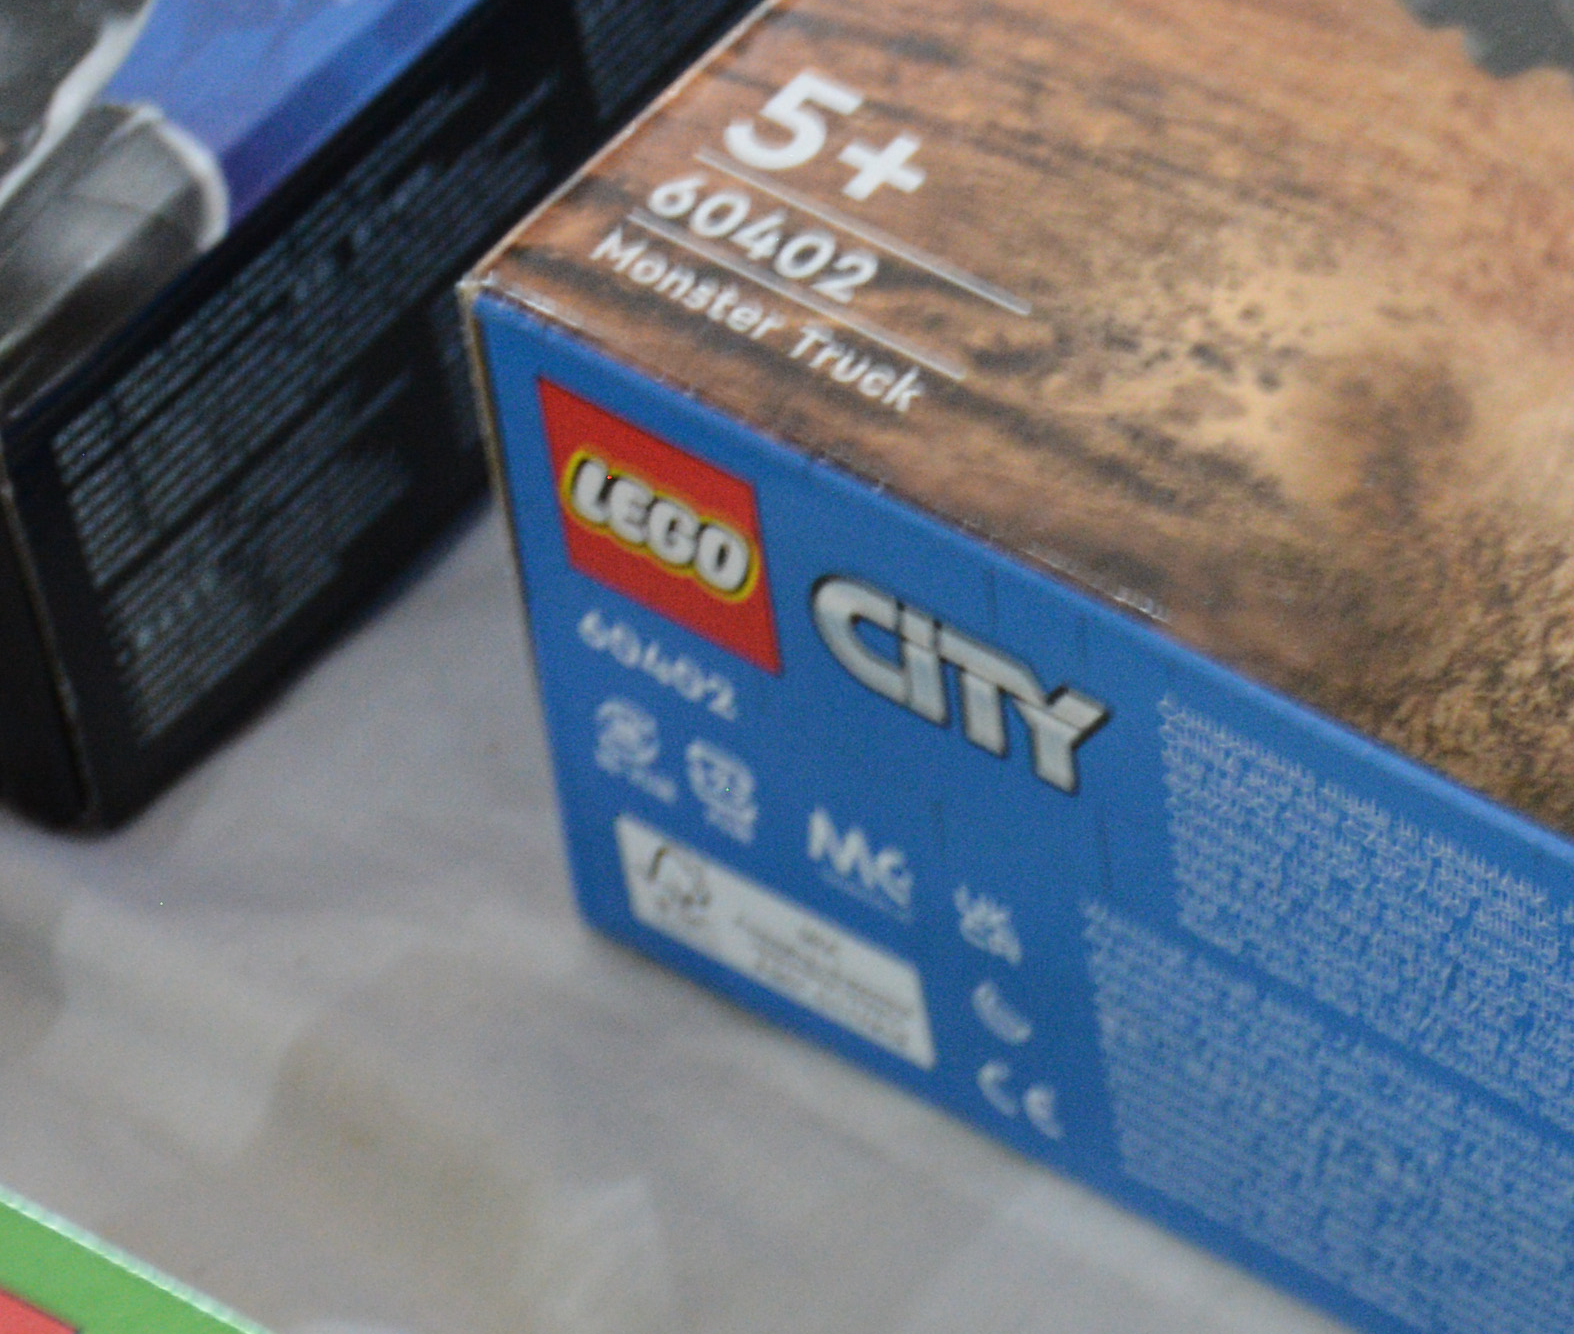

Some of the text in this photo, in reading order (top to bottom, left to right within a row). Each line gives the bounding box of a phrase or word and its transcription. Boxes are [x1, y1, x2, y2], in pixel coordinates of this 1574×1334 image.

[724, 67, 925, 202] 5+
[646, 176, 878, 304] 60402
[591, 225, 923, 414] Monster Truck
[564, 451, 757, 600] LEGO
